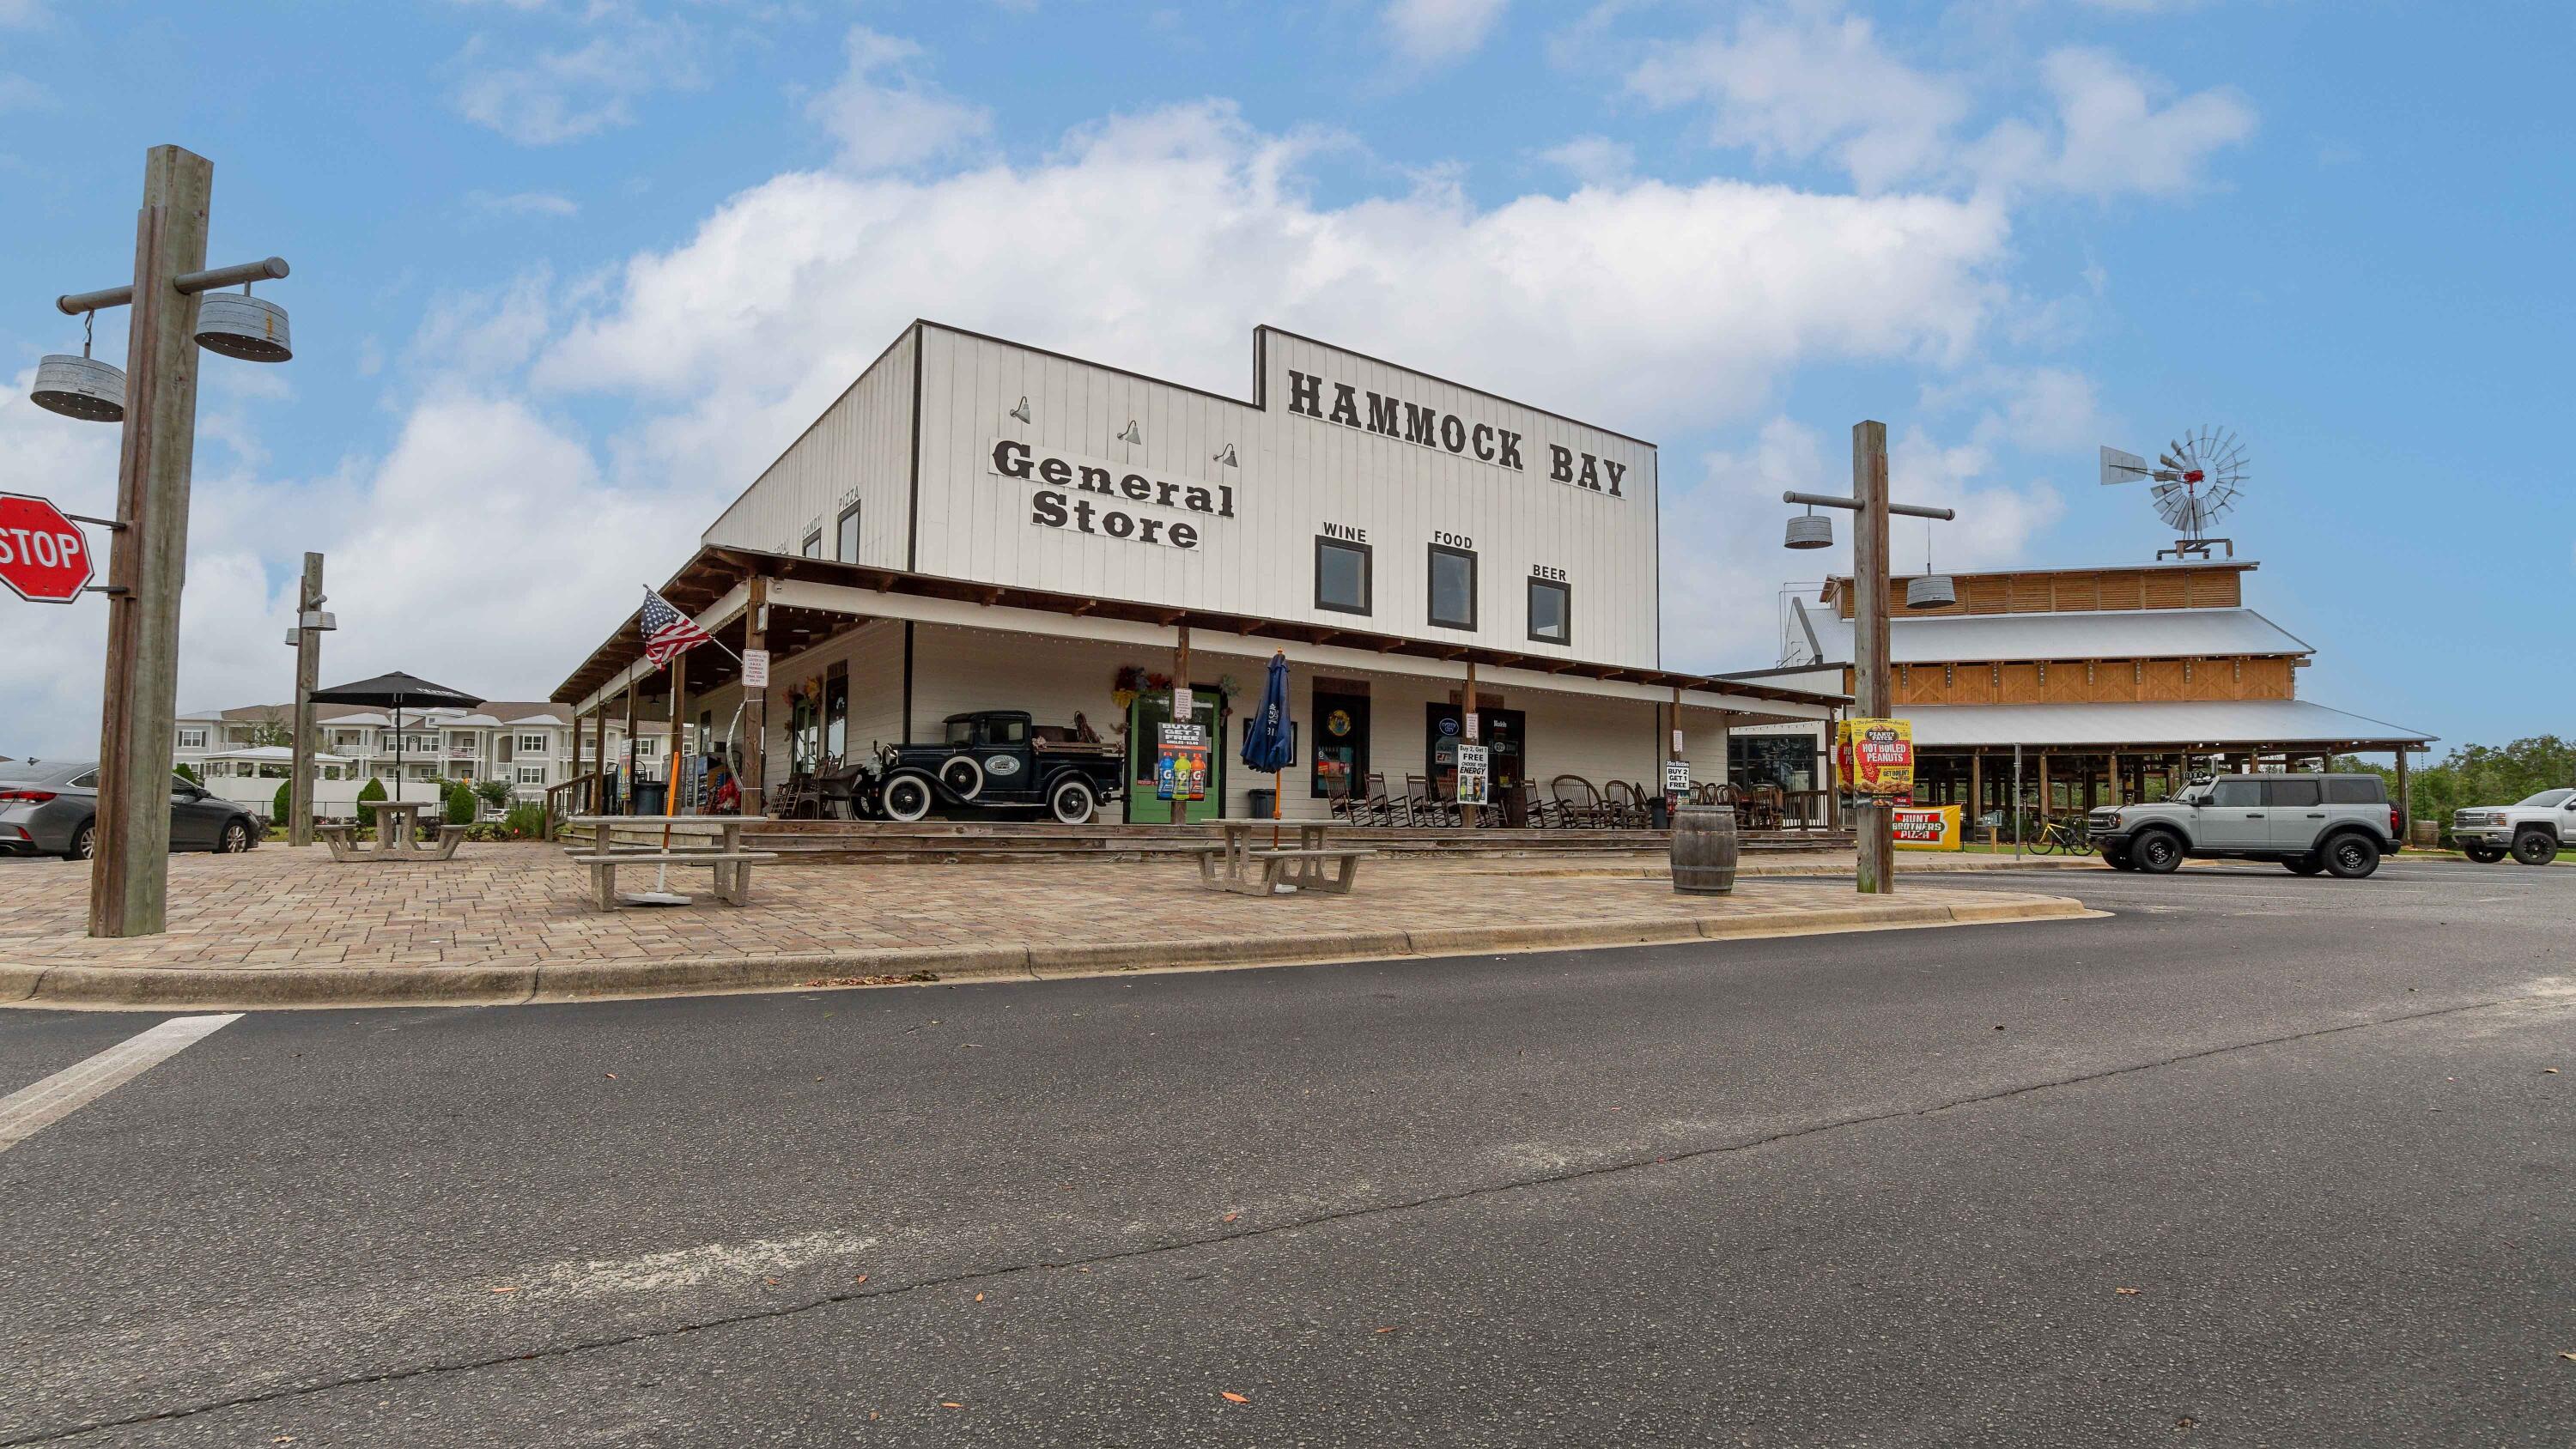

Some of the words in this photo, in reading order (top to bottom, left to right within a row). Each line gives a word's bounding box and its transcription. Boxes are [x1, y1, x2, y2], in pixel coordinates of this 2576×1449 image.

[1289, 369, 1523, 470] HAMMOCK
[1549, 443, 1626, 498] BAY
[992, 440, 1235, 518] General
[1032, 490, 1198, 549] Store
[1323, 521, 1366, 543] WINE
[1434, 530, 1473, 549] FOOD
[0, 527, 80, 568] STOP
[1533, 564, 1566, 582] BEER
[1844, 746, 1852, 755] HO
[1862, 743, 1878, 753] HOT
[1879, 743, 1905, 753] BOILED
[1463, 753, 1484, 761] FREE
[1867, 753, 1904, 762] PEANUTS
[1163, 769, 1172, 779] G
[1178, 770, 1187, 781] G
[1194, 770, 1201, 780] G
[1460, 766, 1486, 775] ENERGY
[1902, 814, 1930, 823] HUNT
[1893, 822, 1941, 831] BROTHERS
[1900, 830, 1929, 839] PIZZA
